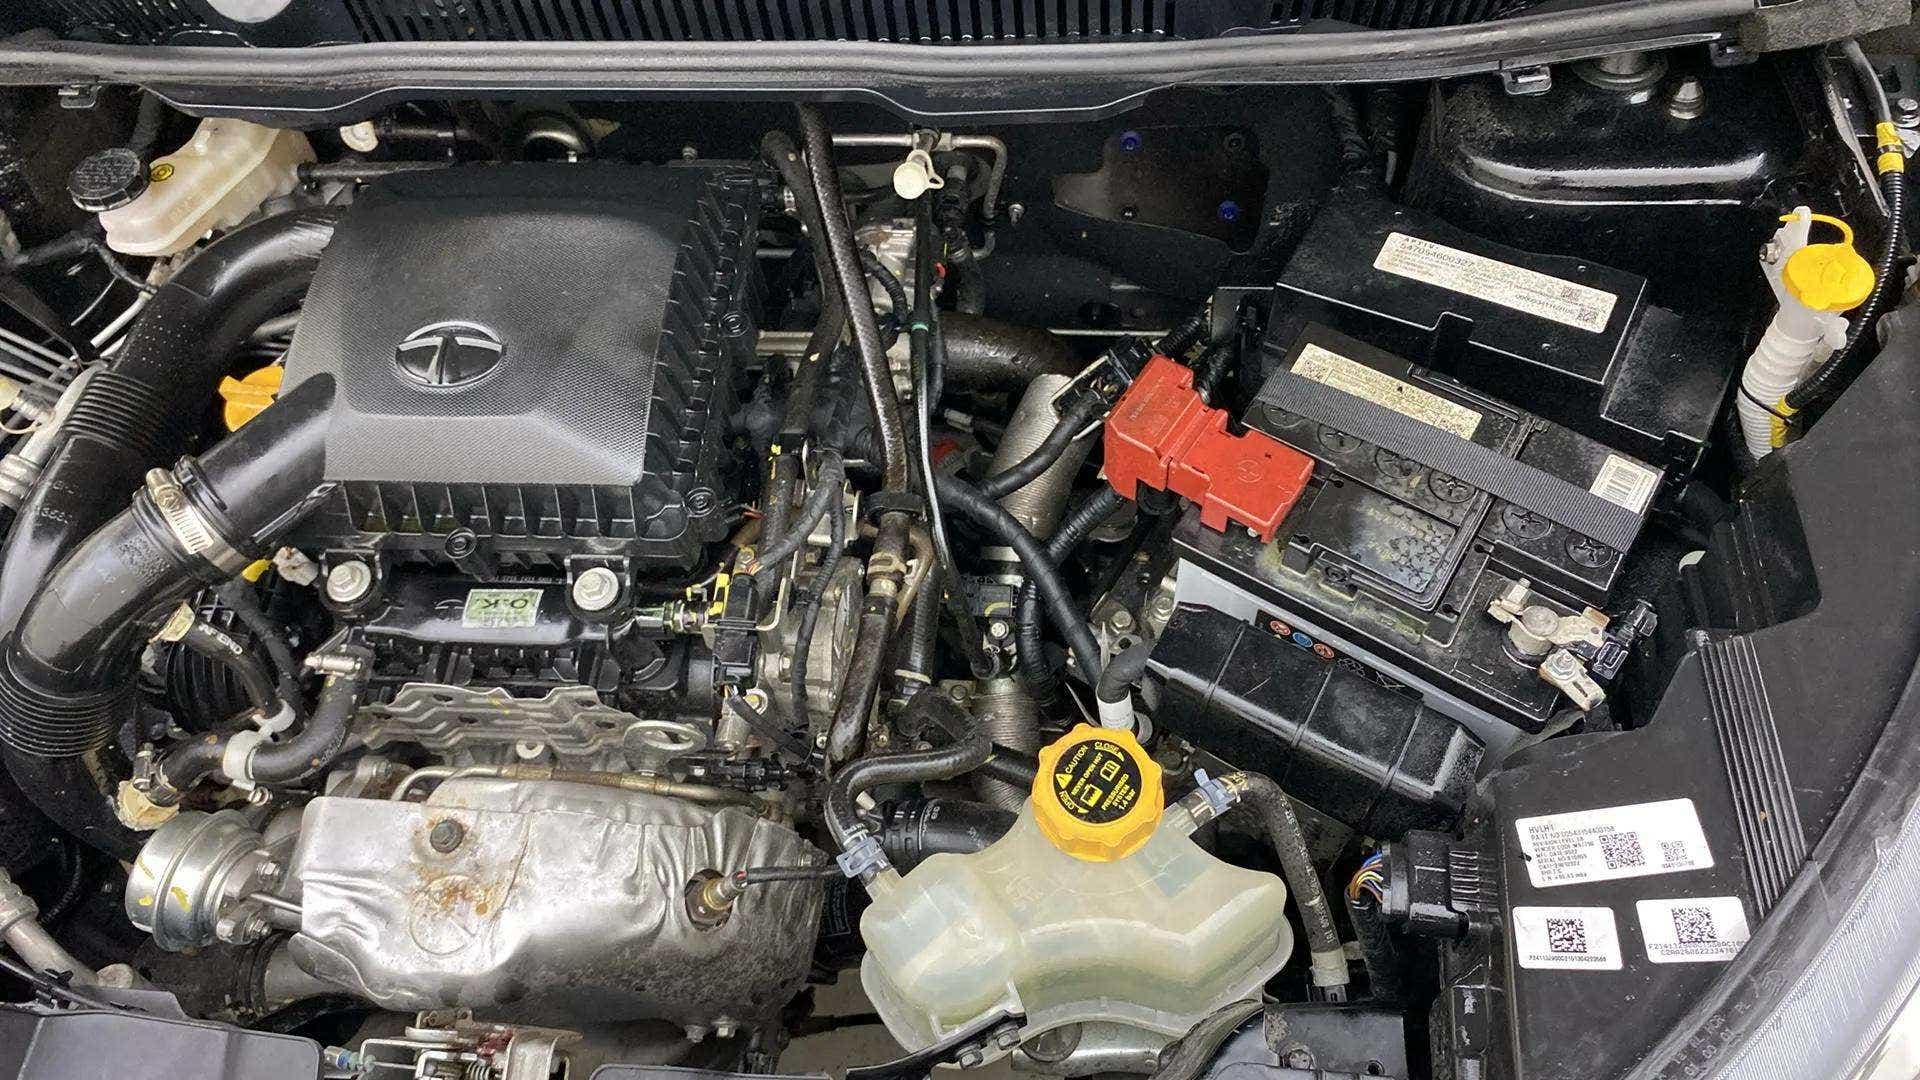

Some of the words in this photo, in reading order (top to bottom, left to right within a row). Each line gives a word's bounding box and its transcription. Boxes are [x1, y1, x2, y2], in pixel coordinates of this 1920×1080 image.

[1094, 741, 1120, 753] CLOSE
[1065, 744, 1089, 774] CAUTION
[1071, 777, 1085, 795] NEVER
[1083, 763, 1096, 778] OPEN
[1112, 784, 1130, 807] SYSTEM
[1125, 789, 1136, 801] bar
